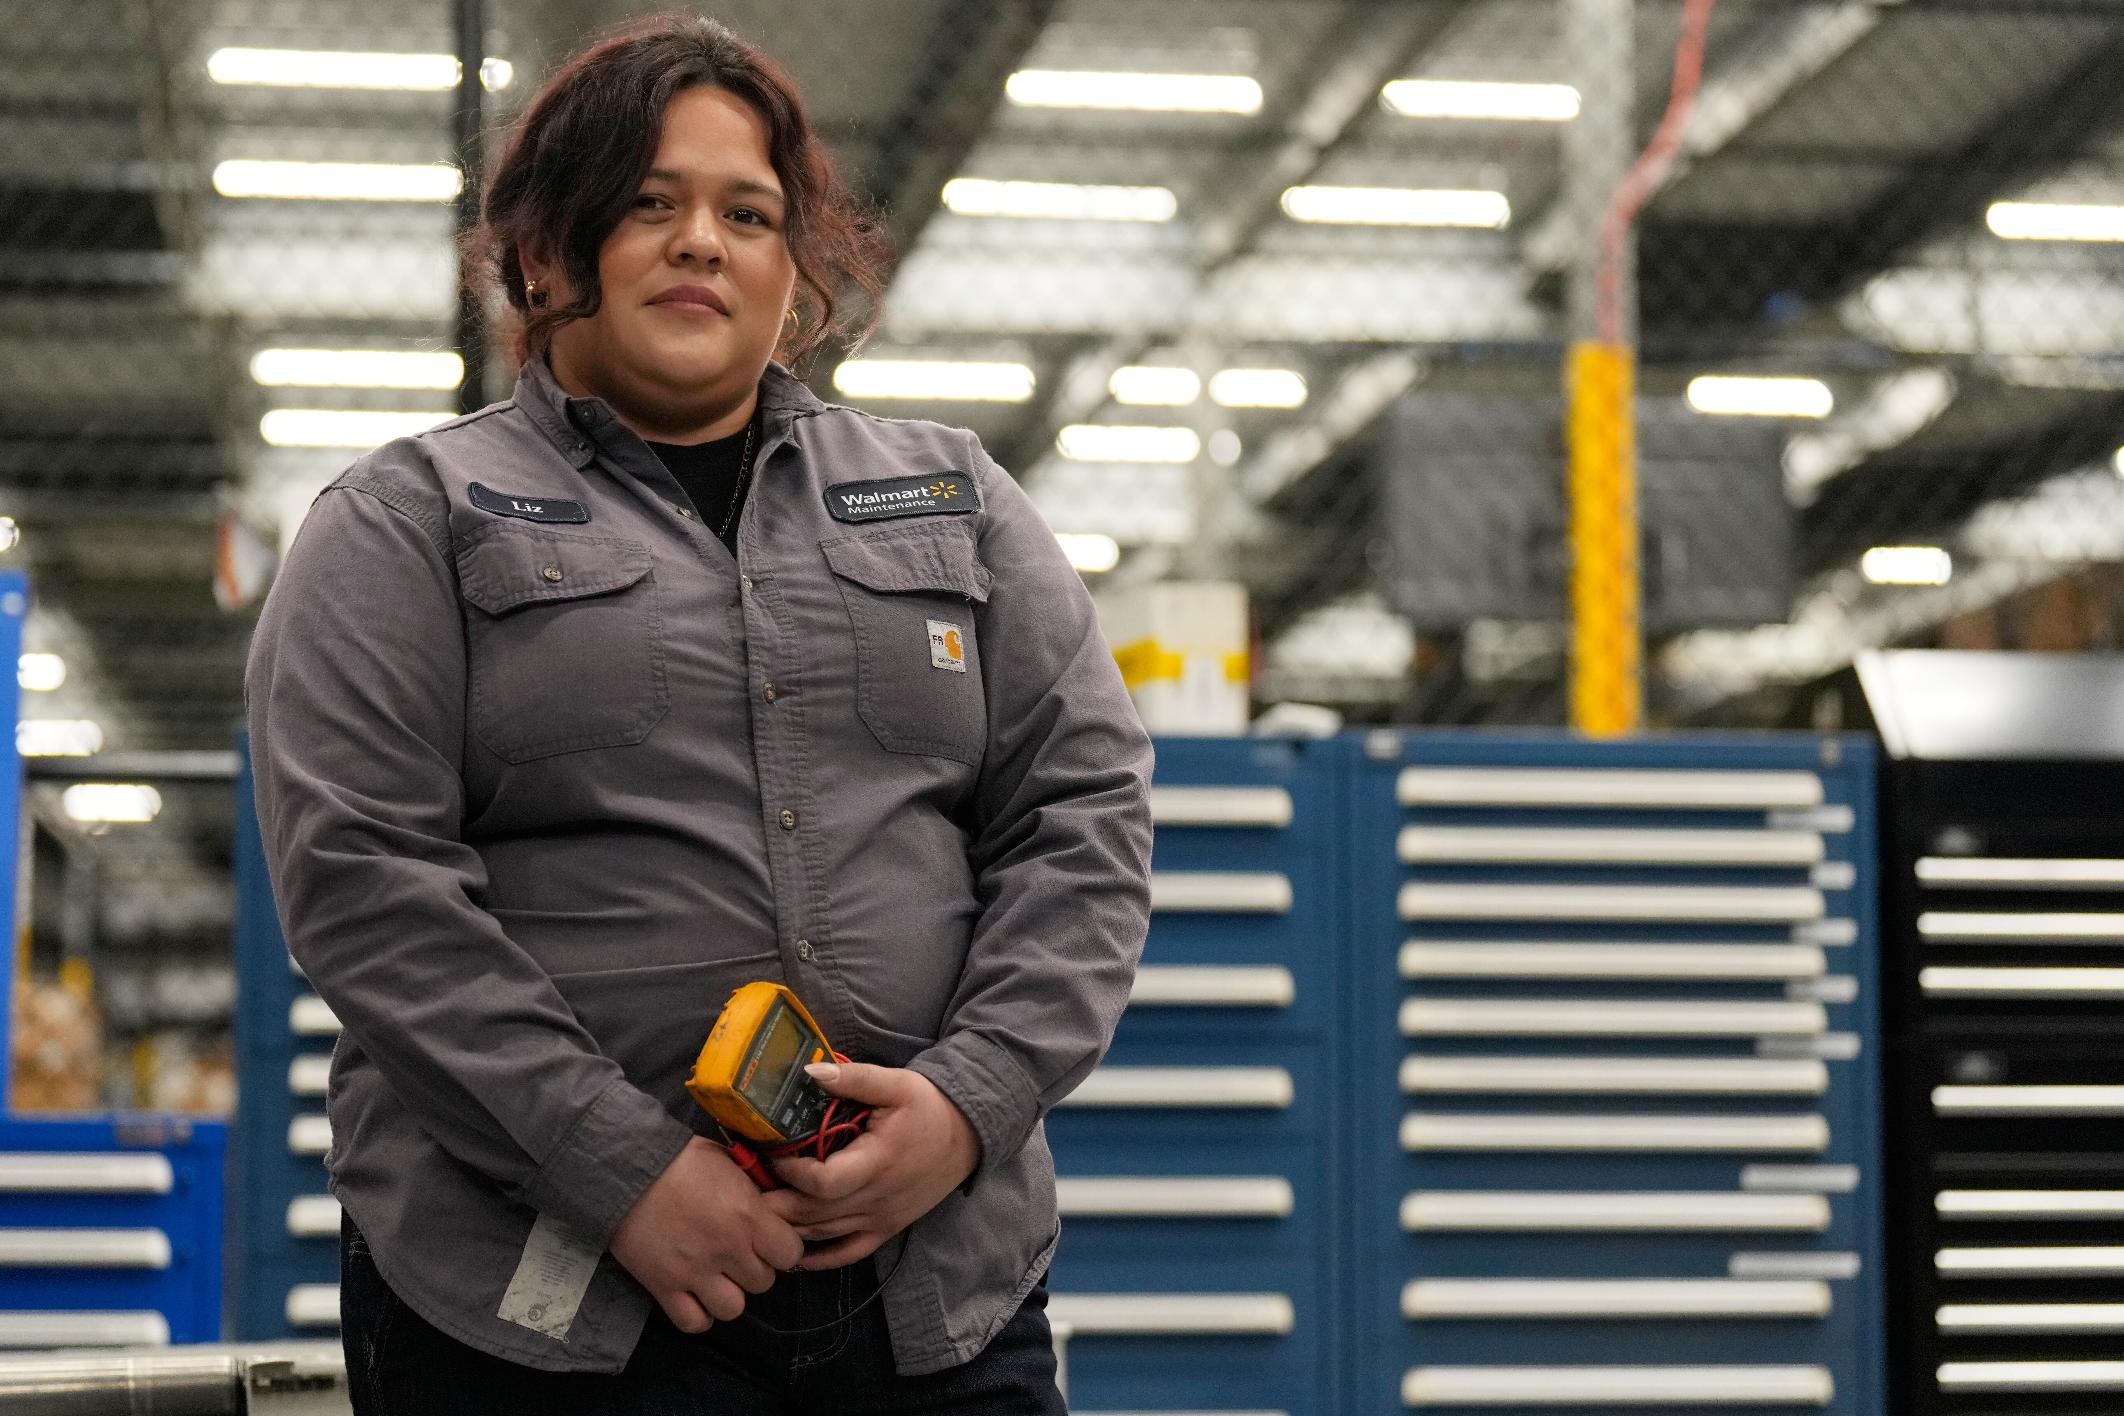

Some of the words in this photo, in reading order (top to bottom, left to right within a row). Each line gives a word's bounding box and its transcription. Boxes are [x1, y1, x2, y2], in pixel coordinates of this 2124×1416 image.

[840, 486, 931, 506] Walmart
[511, 501, 543, 513] Liz
[848, 499, 936, 514] Maintenance
[932, 634, 944, 646] FR
